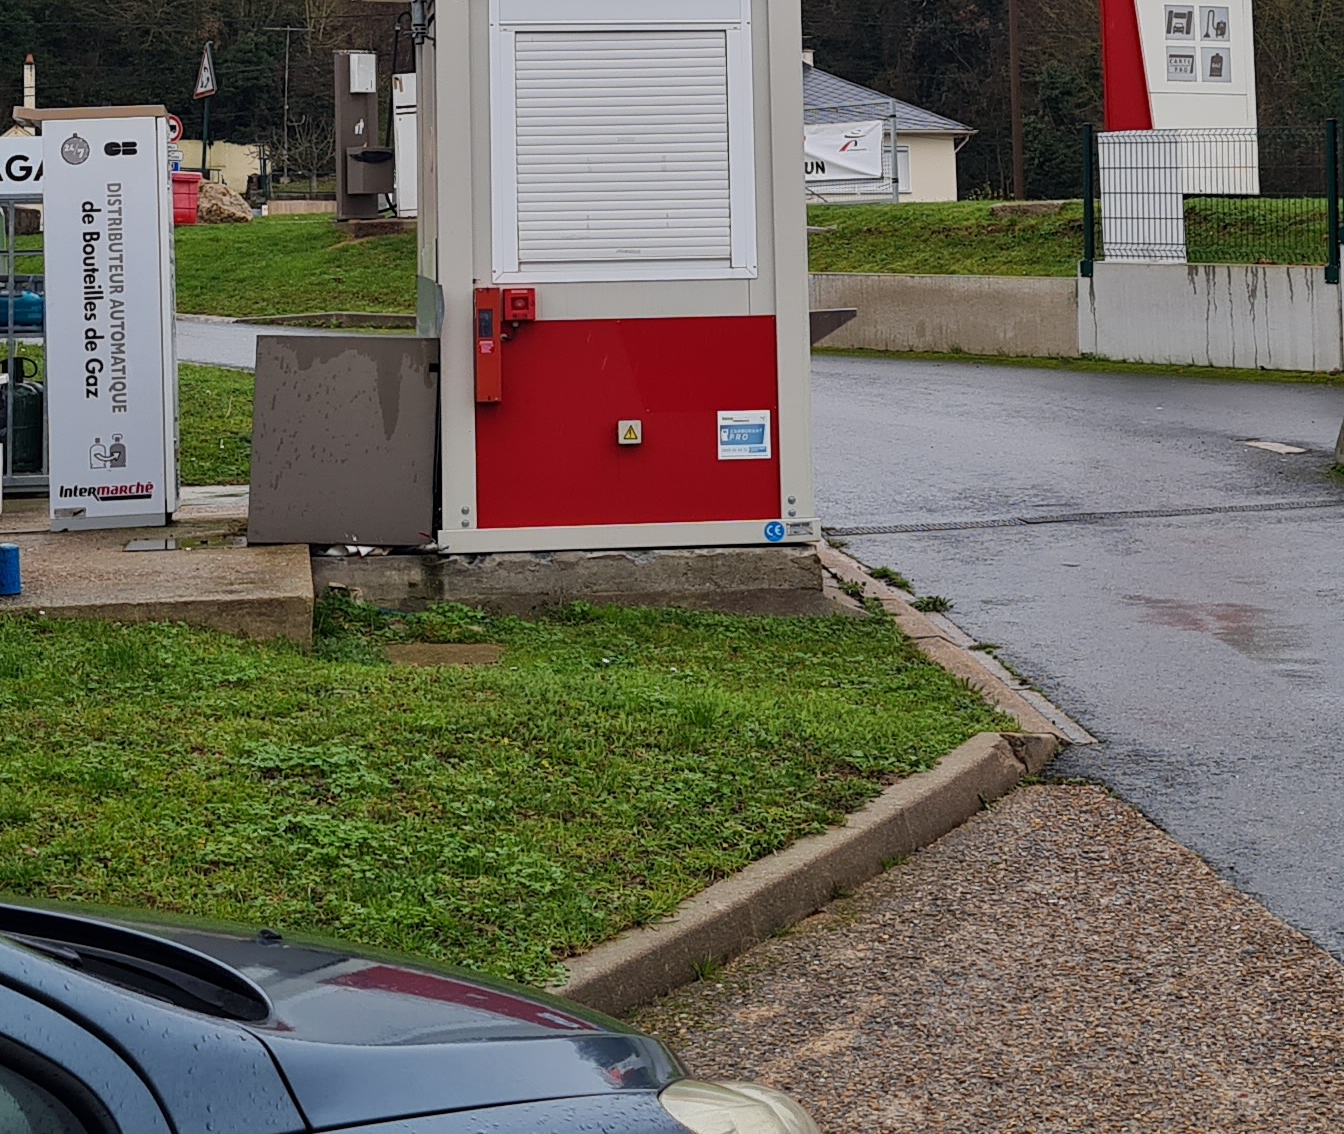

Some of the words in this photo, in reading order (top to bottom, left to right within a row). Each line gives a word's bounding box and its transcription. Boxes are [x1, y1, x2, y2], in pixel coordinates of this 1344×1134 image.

[81, 201, 102, 225] de
[107, 182, 124, 295] DISTRIBUTEUR
[82, 232, 104, 322] Bouteilles
[85, 328, 105, 352] de
[108, 299, 127, 413] AUTOMATIQUE
[85, 358, 104, 398] Gaz
[729, 433, 749, 441] PRO
[59, 482, 154, 500] Intermarché
[766, 525, 782, 536] CE
